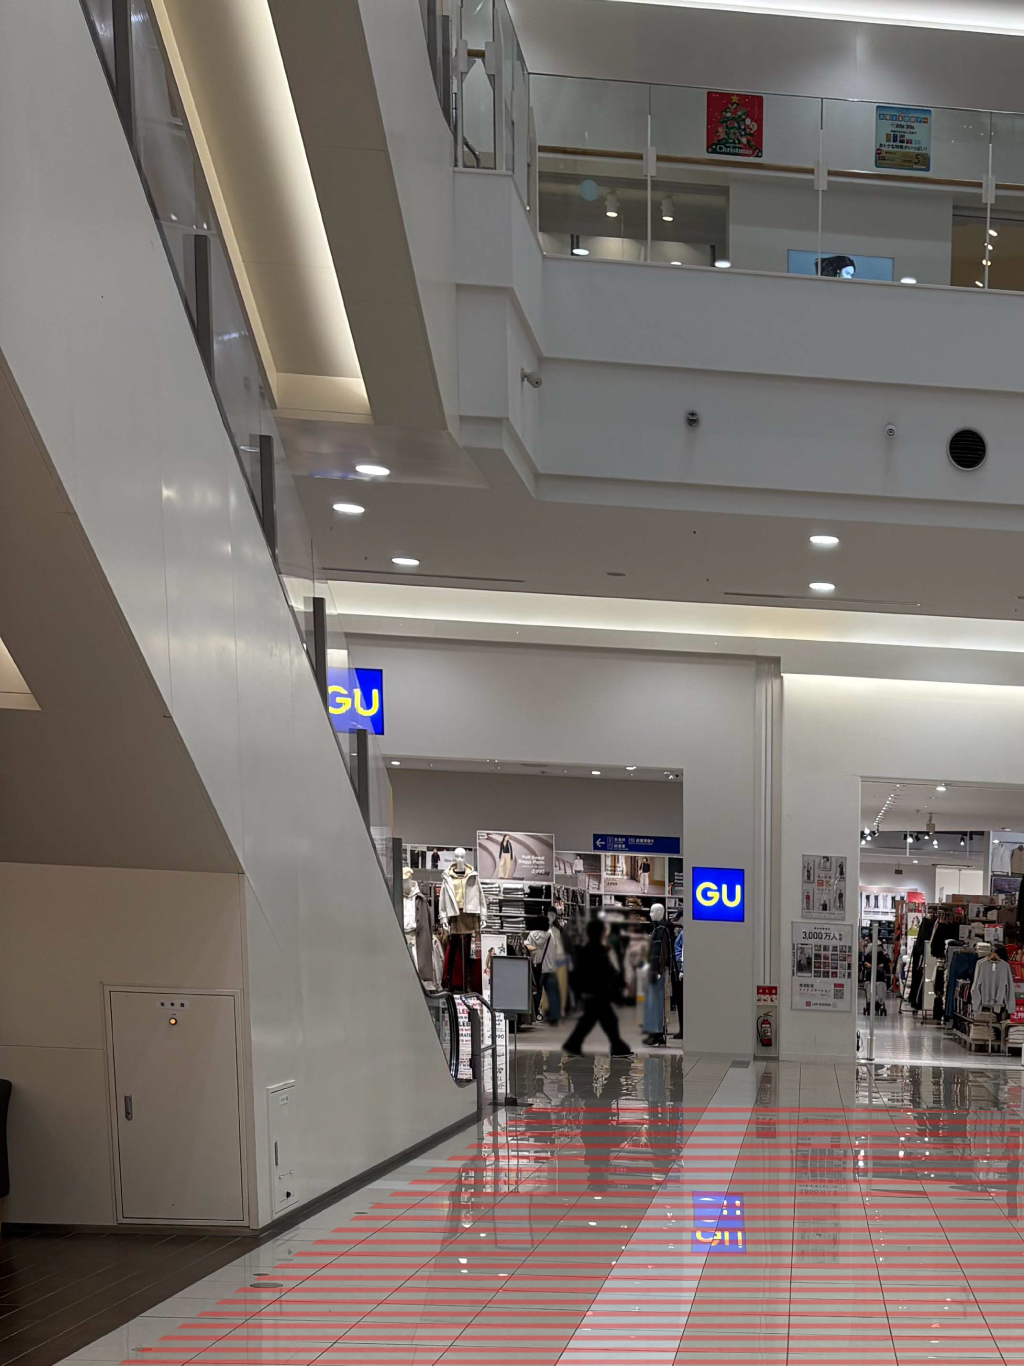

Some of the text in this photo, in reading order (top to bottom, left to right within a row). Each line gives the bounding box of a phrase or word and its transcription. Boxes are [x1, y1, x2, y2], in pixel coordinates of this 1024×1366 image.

[716, 144, 753, 154] Christmas
[328, 685, 379, 717] GU
[696, 881, 742, 908] GU
[802, 931, 838, 941] 3,000万人
